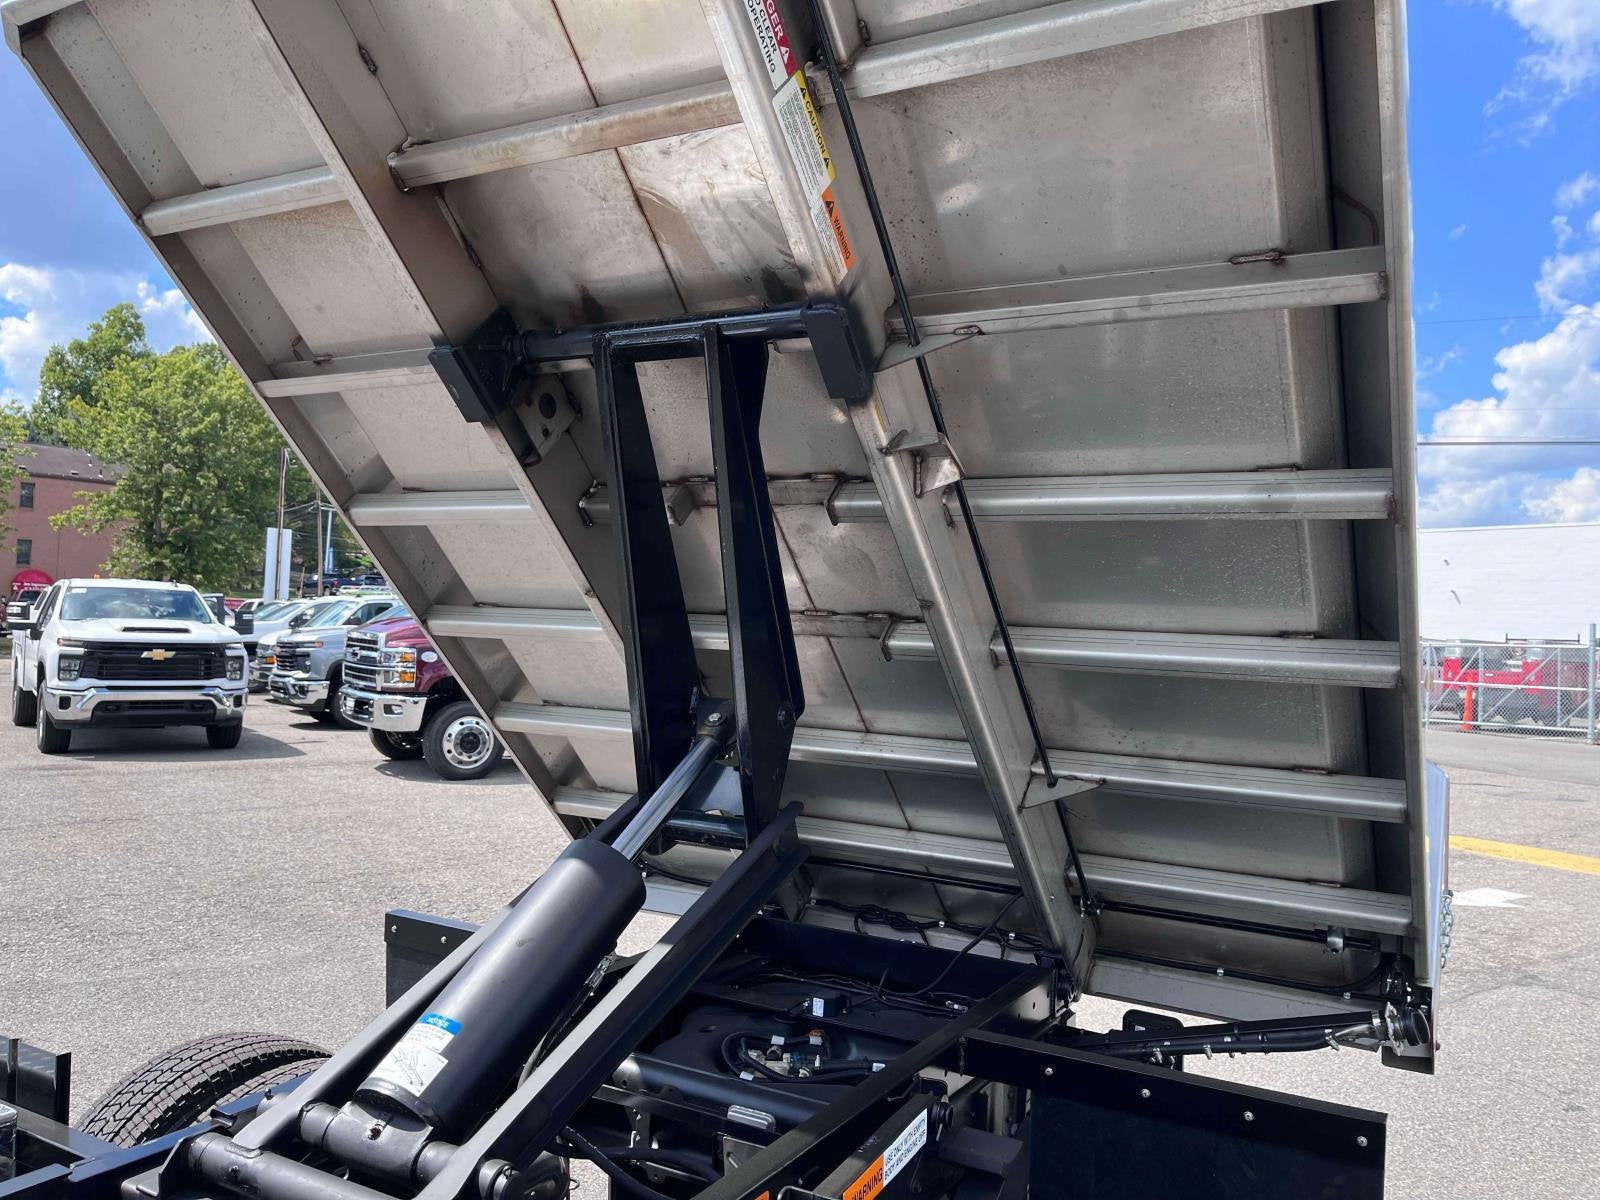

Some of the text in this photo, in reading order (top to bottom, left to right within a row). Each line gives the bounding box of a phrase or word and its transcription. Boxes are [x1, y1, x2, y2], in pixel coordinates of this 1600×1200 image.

[748, 0, 776, 73] OPERATING
[759, 9, 777, 54] CLEAR
[805, 100, 825, 154] CAUTION
[834, 217, 851, 260] WARNING
[851, 1167, 884, 1200] WARNING
[884, 1163, 897, 1181] BODY
